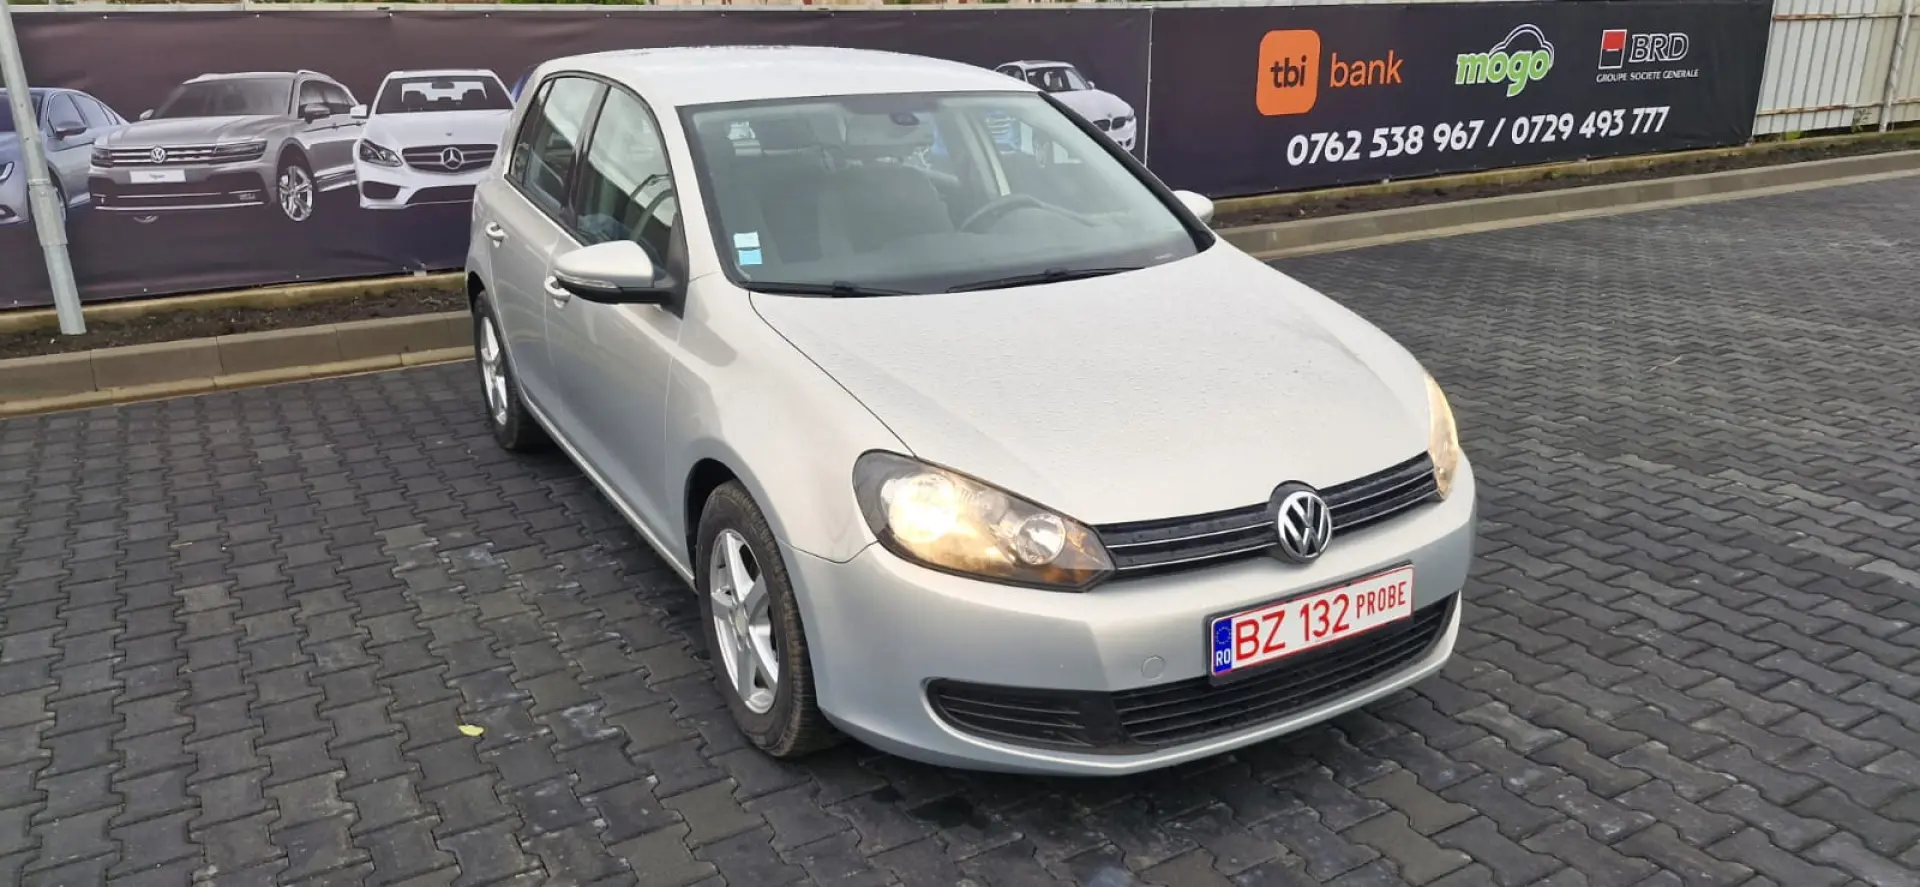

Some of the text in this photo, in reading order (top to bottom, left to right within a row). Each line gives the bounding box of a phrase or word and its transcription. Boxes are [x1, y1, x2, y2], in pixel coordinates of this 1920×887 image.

[1270, 49, 1404, 88] tbi bank
[1629, 33, 1689, 62] BRD
[1455, 49, 1551, 97] mogo
[1596, 69, 1699, 83] GROUPE SOCIETE GENERALE
[1286, 106, 1670, 166] 0762 538 967 / 0729 493 777
[1278, 491, 1332, 561] VW
[1235, 581, 1407, 660] BZ 132 PROBE
[1216, 648, 1231, 667] RO
